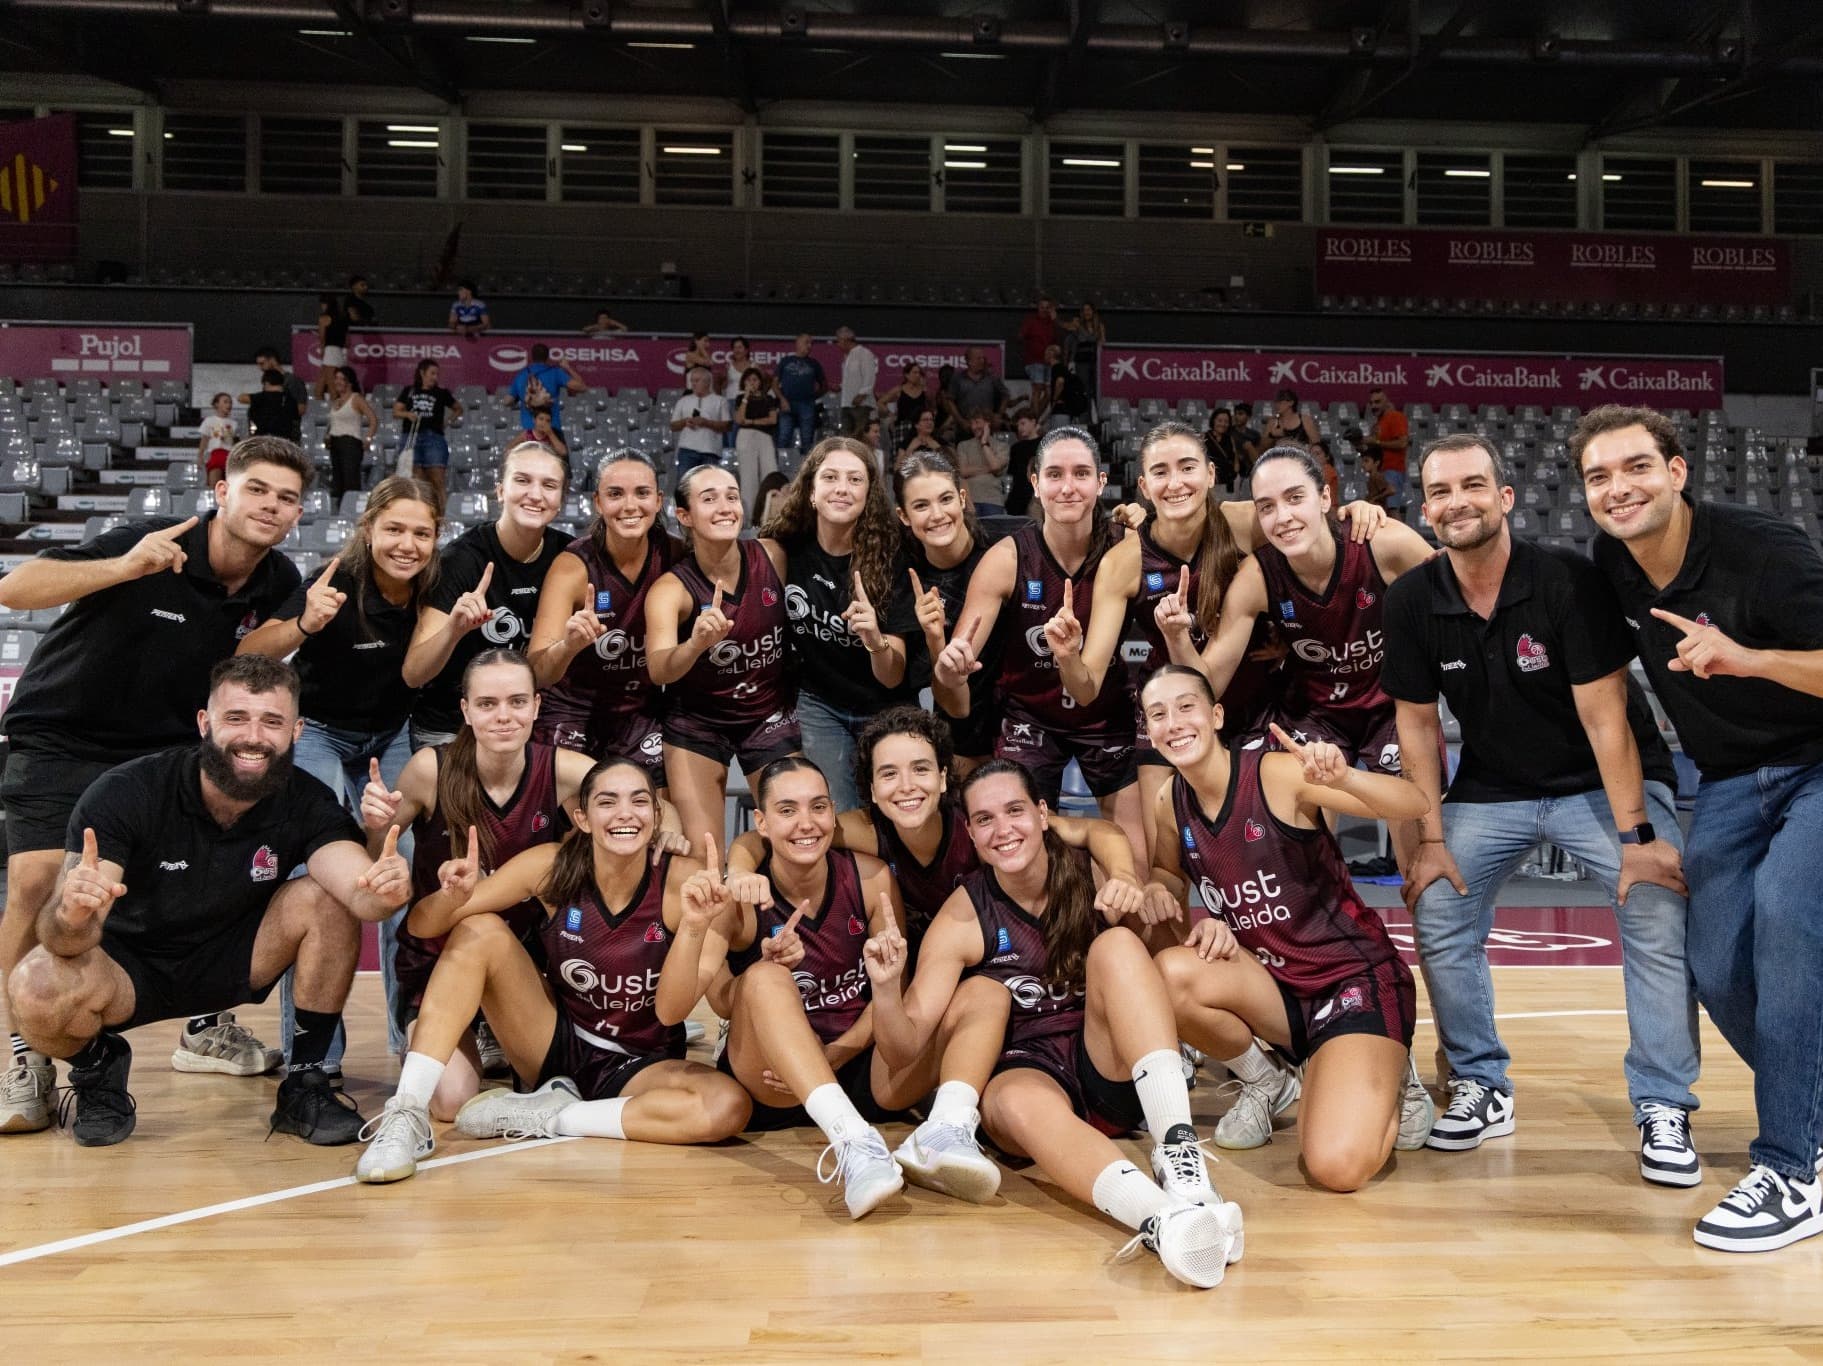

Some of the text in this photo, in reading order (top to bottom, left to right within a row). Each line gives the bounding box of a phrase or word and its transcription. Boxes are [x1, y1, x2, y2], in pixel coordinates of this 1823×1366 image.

[1325, 238, 1412, 257] ROBLES
[1450, 241, 1534, 260] ROBLES
[1571, 244, 1656, 263] ROBLES
[1693, 247, 1776, 266] ROBLES
[80, 334, 143, 359] Pujol
[354, 343, 462, 360] COSEHISA
[548, 347, 640, 362] OSEHISA
[885, 355, 969, 368] COSEHIS
[1142, 358, 1251, 381] CaixaBank
[1301, 362, 1408, 385] CaixaBank
[1456, 364, 1562, 389] CaixaBank
[1609, 367, 1715, 391] CaixaBank
[1200, 870, 1281, 915] Gust
[560, 958, 662, 995] Gust
